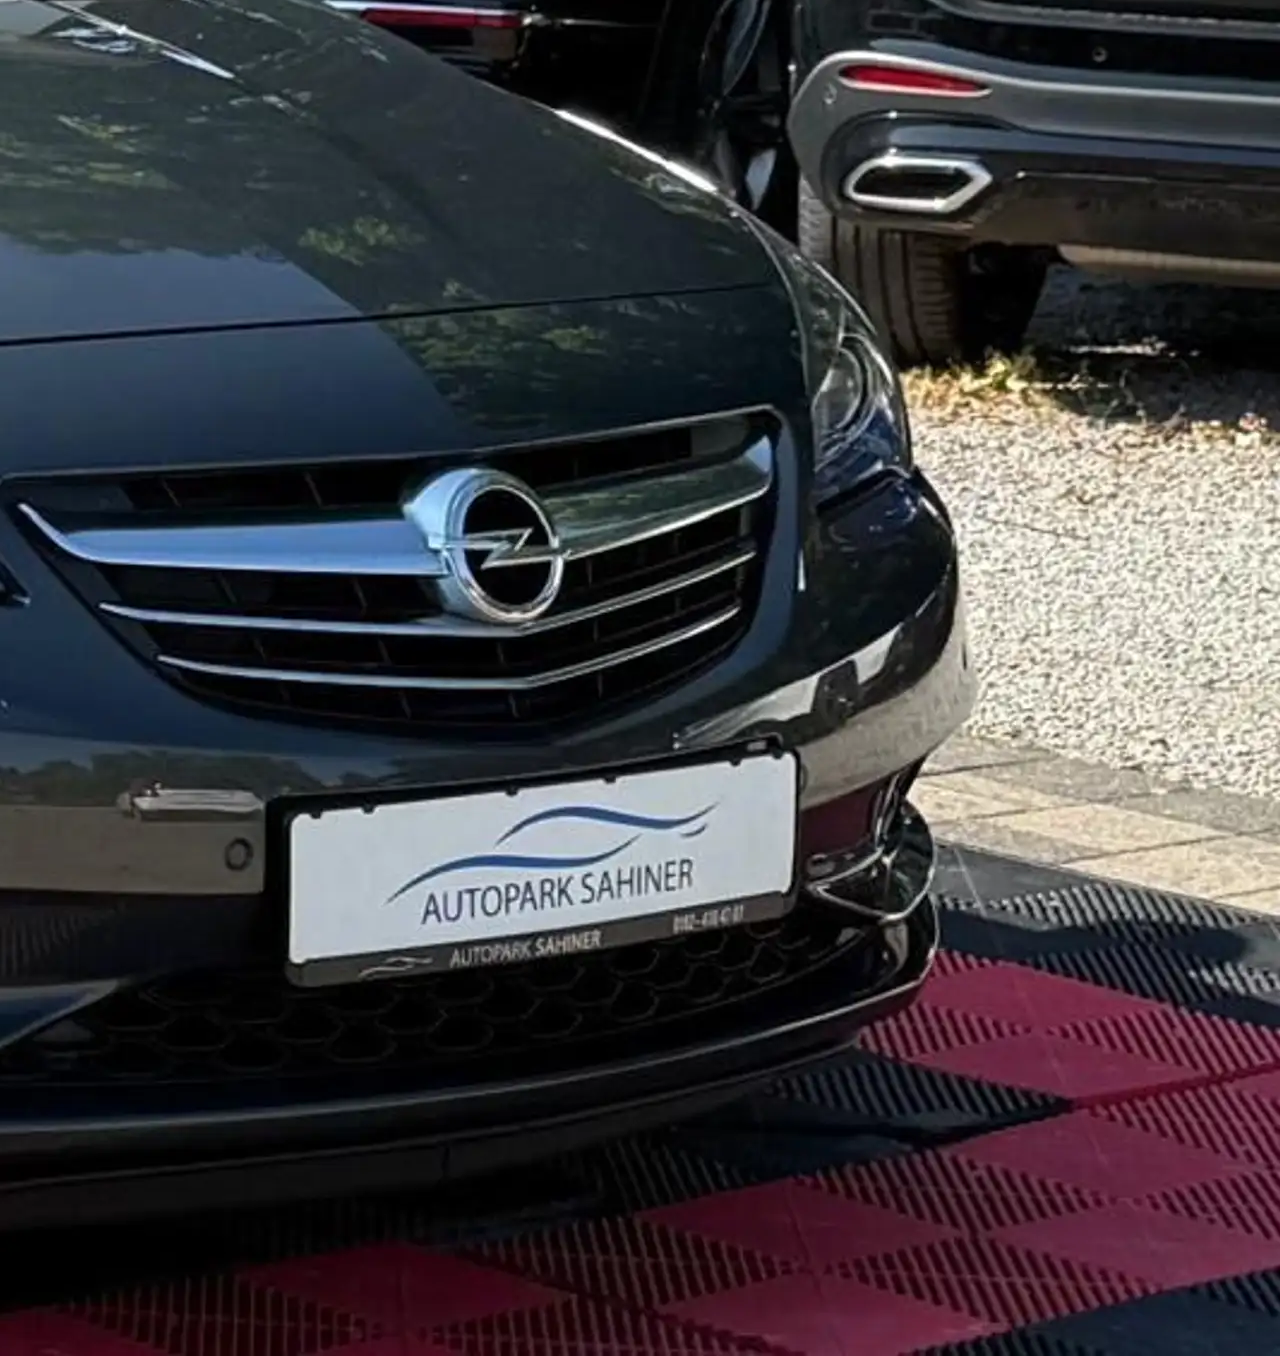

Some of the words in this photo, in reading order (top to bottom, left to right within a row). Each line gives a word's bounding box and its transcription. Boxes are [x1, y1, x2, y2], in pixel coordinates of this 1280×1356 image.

[421, 874, 574, 925] AUTOPARK
[580, 858, 694, 905] SAHINER
[449, 941, 531, 969] AUTOPARK
[535, 929, 602, 957] SAHINER
